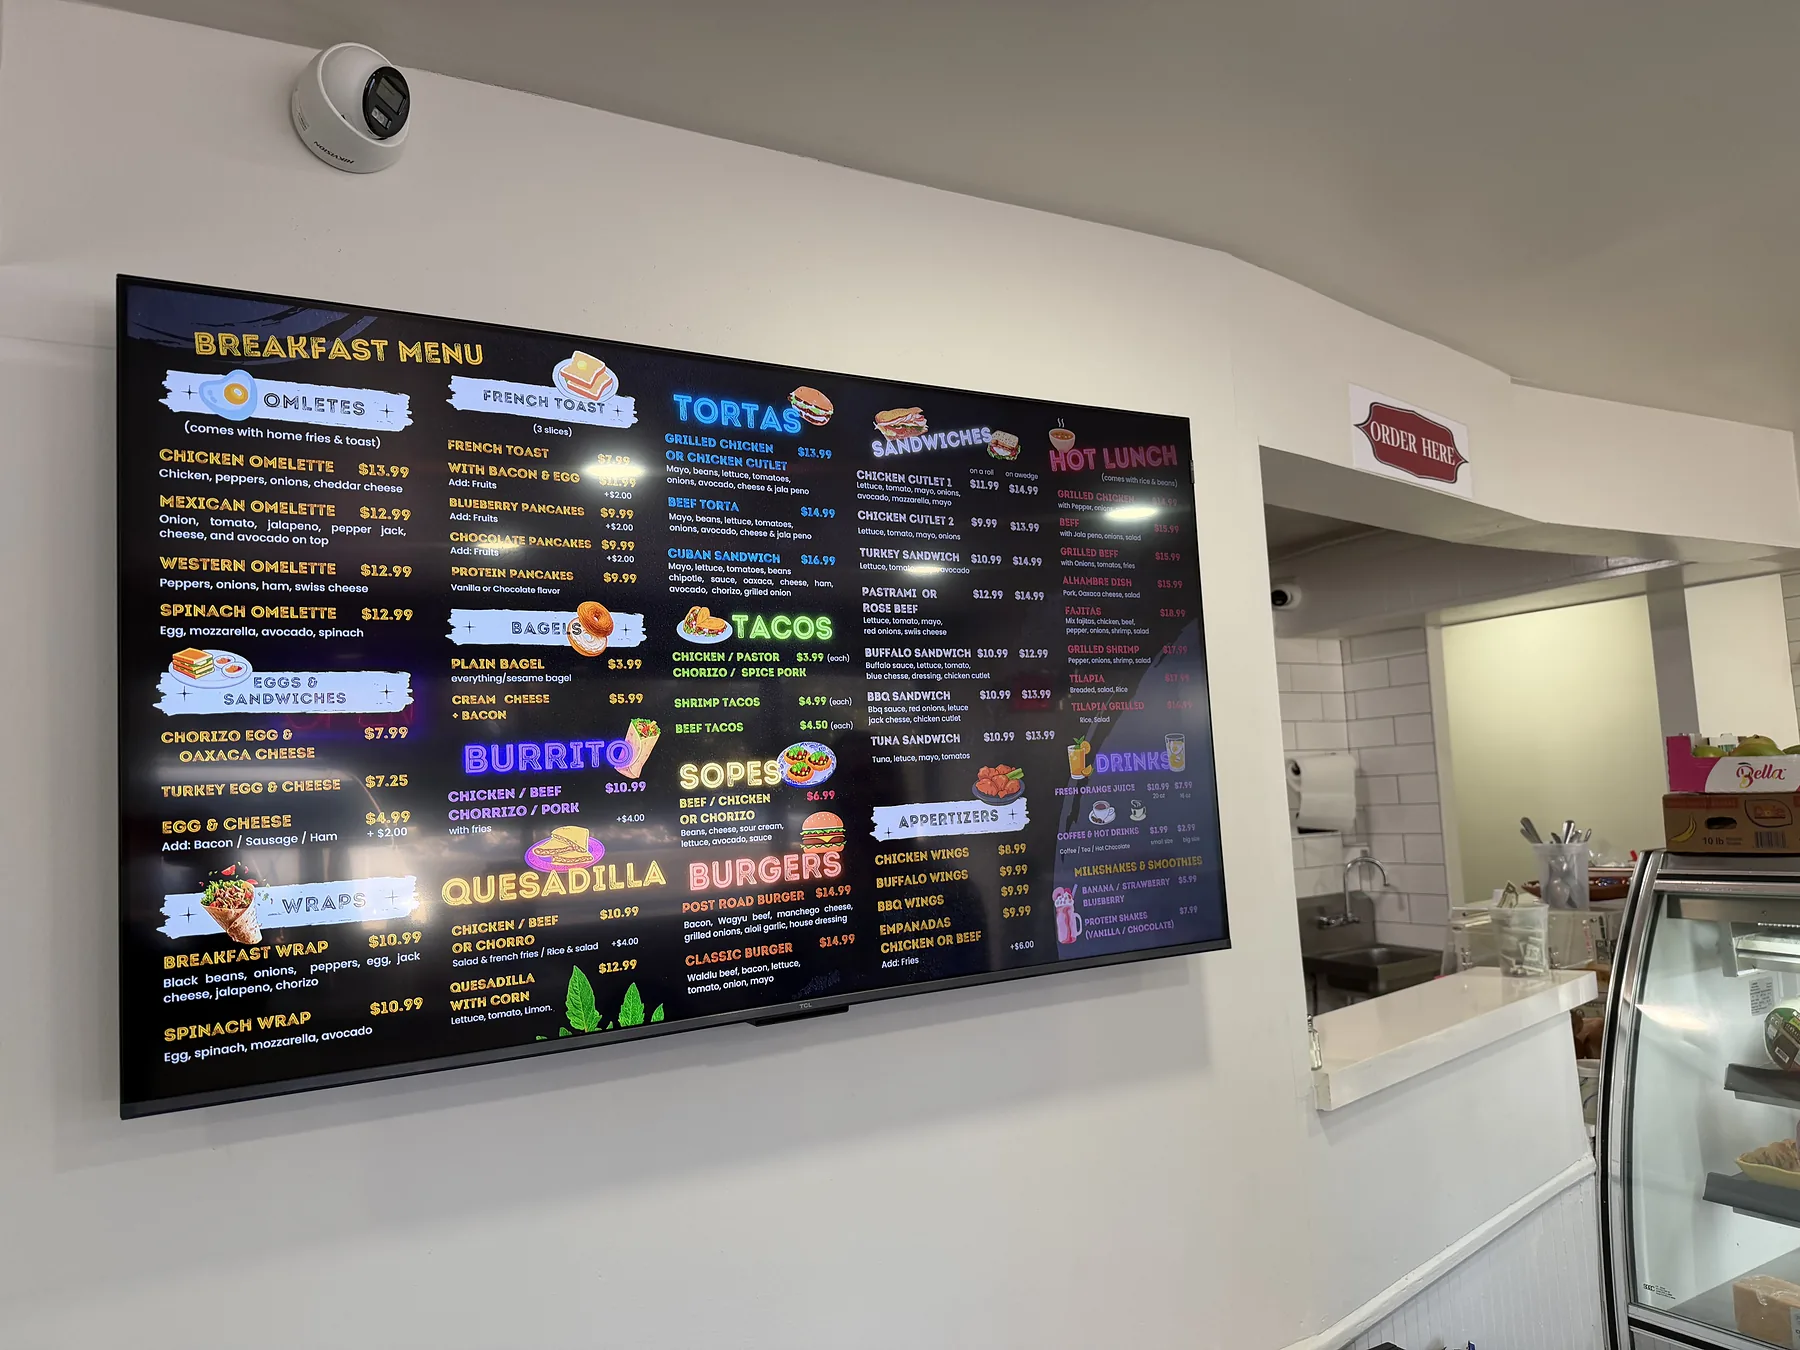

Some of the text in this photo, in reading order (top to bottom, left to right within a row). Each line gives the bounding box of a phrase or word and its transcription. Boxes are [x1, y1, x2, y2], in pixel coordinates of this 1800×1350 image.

[194, 331, 483, 365] BREAKFAST MENU
[263, 393, 366, 416] OMLETES
[483, 389, 606, 414] FRENCH TOAST
[673, 394, 802, 434] TORTAS
[184, 420, 381, 449] (comes with home fries & toast)
[534, 424, 572, 437] (3 slices)
[665, 433, 832, 459] GRILLED CHICKEN $13.99
[872, 427, 992, 457] SANDWICHES
[1370, 421, 1455, 465] ORDER HERE
[159, 449, 409, 478] CHICKEN OMELETTE $13.99
[1050, 445, 1177, 472] HOT LUNCH
[159, 468, 403, 493] Chicken, peppers, onions, cheddar cheese
[1102, 473, 1125, 482] (comes
[450, 498, 634, 519] BLUEBERRY PANCAKES $9.99
[668, 497, 835, 518] BEEF TORTA $14.99
[669, 513, 793, 528] Mayo, beans, lettuce, tomatoes,
[858, 510, 1039, 532] CHICKEN CUTLET 2 $9.99 $13.99
[1061, 547, 1096, 557] GRILLED
[160, 557, 412, 578] WESTERN OMELETTE $12.99
[451, 584, 480, 592] Vanilla
[493, 585, 536, 593] Chocolate
[537, 586, 560, 594] flavor
[1063, 576, 1108, 586] ALHAMBRE
[1111, 578, 1132, 586] DISH
[862, 587, 1044, 600] PASTRAMI OR $12.99 $14.99
[863, 603, 918, 613] ROSE BEEF
[1065, 607, 1101, 616] FAJITAS
[160, 626, 364, 639] Egg, mozzarella, avocado, spinach
[511, 622, 582, 635] BAGELS
[732, 615, 832, 639] TACOS
[451, 659, 642, 670] PLAIN BAGEL $3.99
[253, 676, 301, 689] EGGS
[451, 673, 571, 684] everything/sesame bagel
[1069, 674, 1105, 683] TILAPIA
[223, 692, 347, 706] SANDWICHES
[674, 696, 852, 708] SHRIMP TACOS $4.99 (each)
[871, 731, 1055, 746] TUNA SANDWICH $10.99 $13.99
[464, 740, 635, 774] BURRITO
[679, 760, 782, 790] SOPES
[1736, 762, 1786, 788] Bella
[448, 788, 515, 802] CHICKEN
[530, 786, 561, 798] BEEF
[605, 781, 646, 794] $10.99
[807, 791, 835, 801] $6.99
[1055, 787, 1078, 795] FRESH
[1080, 785, 1111, 794] ORANGE
[1113, 784, 1135, 792] JUICE
[899, 809, 999, 829] APPERTIZERS
[449, 824, 492, 835] with fries
[1057, 827, 1139, 841] COFFEE & HOT DRINKS
[1716, 837, 1724, 845] lb
[875, 843, 1026, 865] CHICKEN WINGS $8.99
[689, 851, 842, 891] BURGERS
[1075, 856, 1202, 877] MILKSHAKES & SMOOTHIES
[442, 860, 666, 906] QUESADILLA
[281, 892, 367, 915] WRAPS
[683, 885, 851, 913] POST ROAD BURGER $14.99
[880, 917, 951, 935] EMPANADAS
[1085, 915, 1118, 926] PROTEIN
[1119, 912, 1147, 922] SHAKES
[164, 931, 422, 969] BREAKFAST WRAP $10.99
[882, 957, 919, 968] Add: Fries
[164, 977, 318, 1003] cheese, jalapeno, chorizo
[688, 976, 774, 994] tomato, onion, mayo
[451, 1005, 553, 1025] Lettuce, tomato, Limon.
